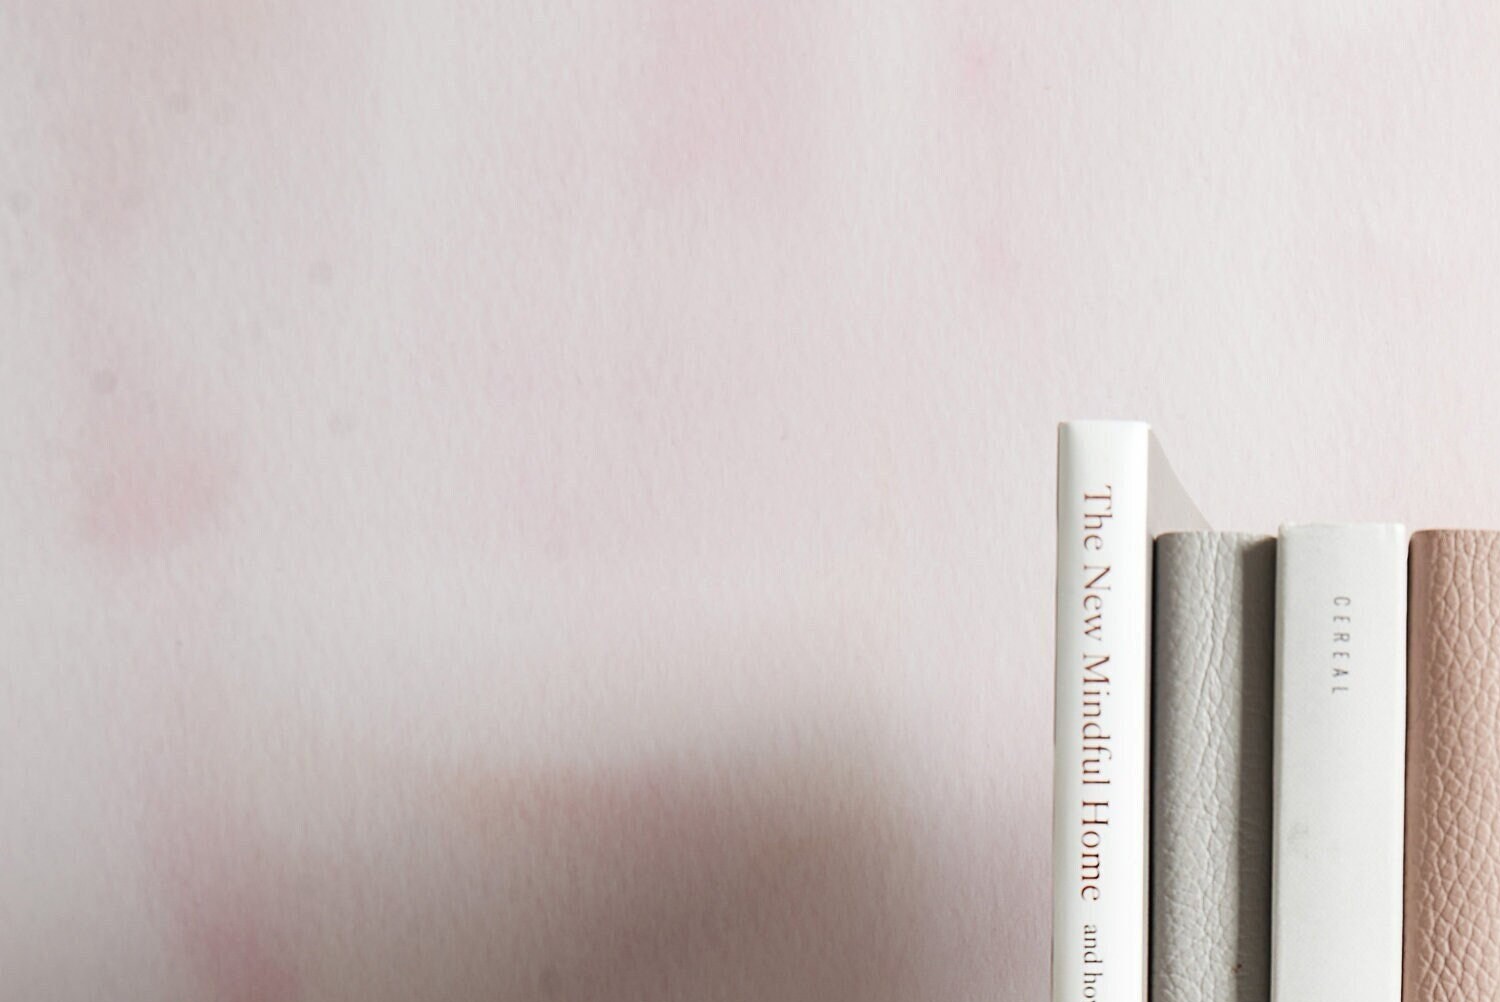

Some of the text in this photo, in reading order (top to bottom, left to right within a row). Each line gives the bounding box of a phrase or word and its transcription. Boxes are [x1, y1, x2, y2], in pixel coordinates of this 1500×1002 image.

[1081, 485, 1113, 901] The New Mindful Home
[1332, 596, 1351, 693] CEREAL
[1084, 925, 1103, 963] and
